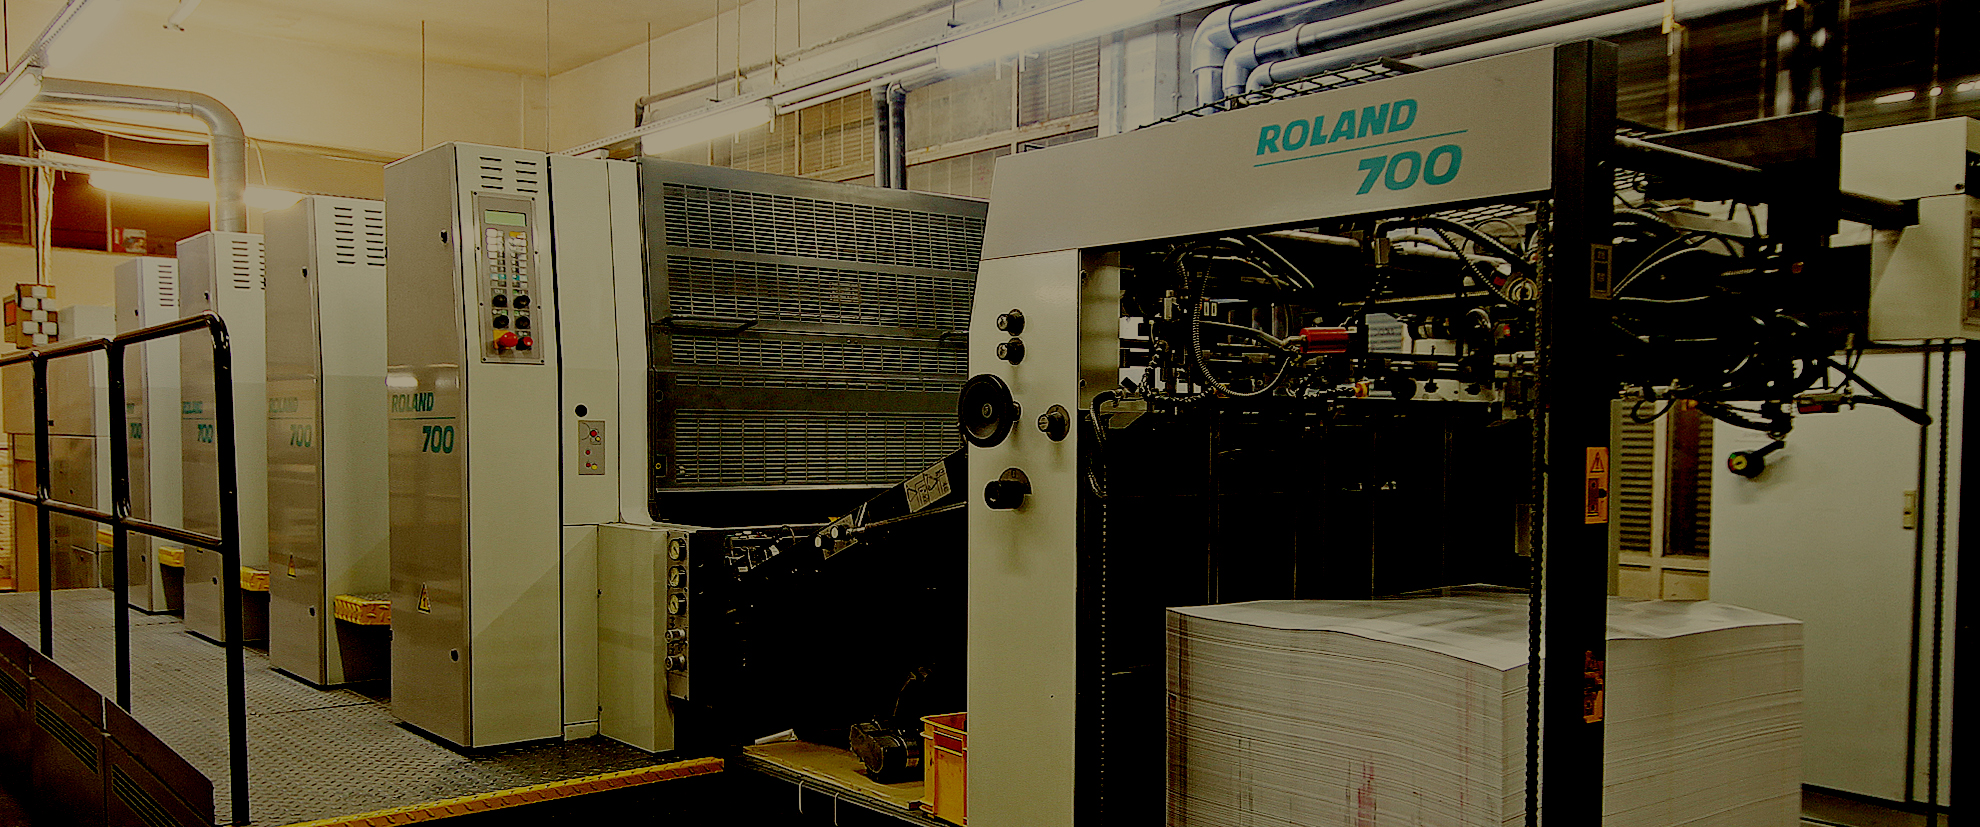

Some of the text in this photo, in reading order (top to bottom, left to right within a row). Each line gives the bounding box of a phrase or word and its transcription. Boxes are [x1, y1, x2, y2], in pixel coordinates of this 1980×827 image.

[1257, 99, 1418, 156] ROLAND
[1356, 144, 1463, 196] 700
[391, 392, 435, 412] ROLAND
[197, 423, 214, 443] 700
[289, 424, 313, 447] 700
[422, 425, 455, 454] 700
